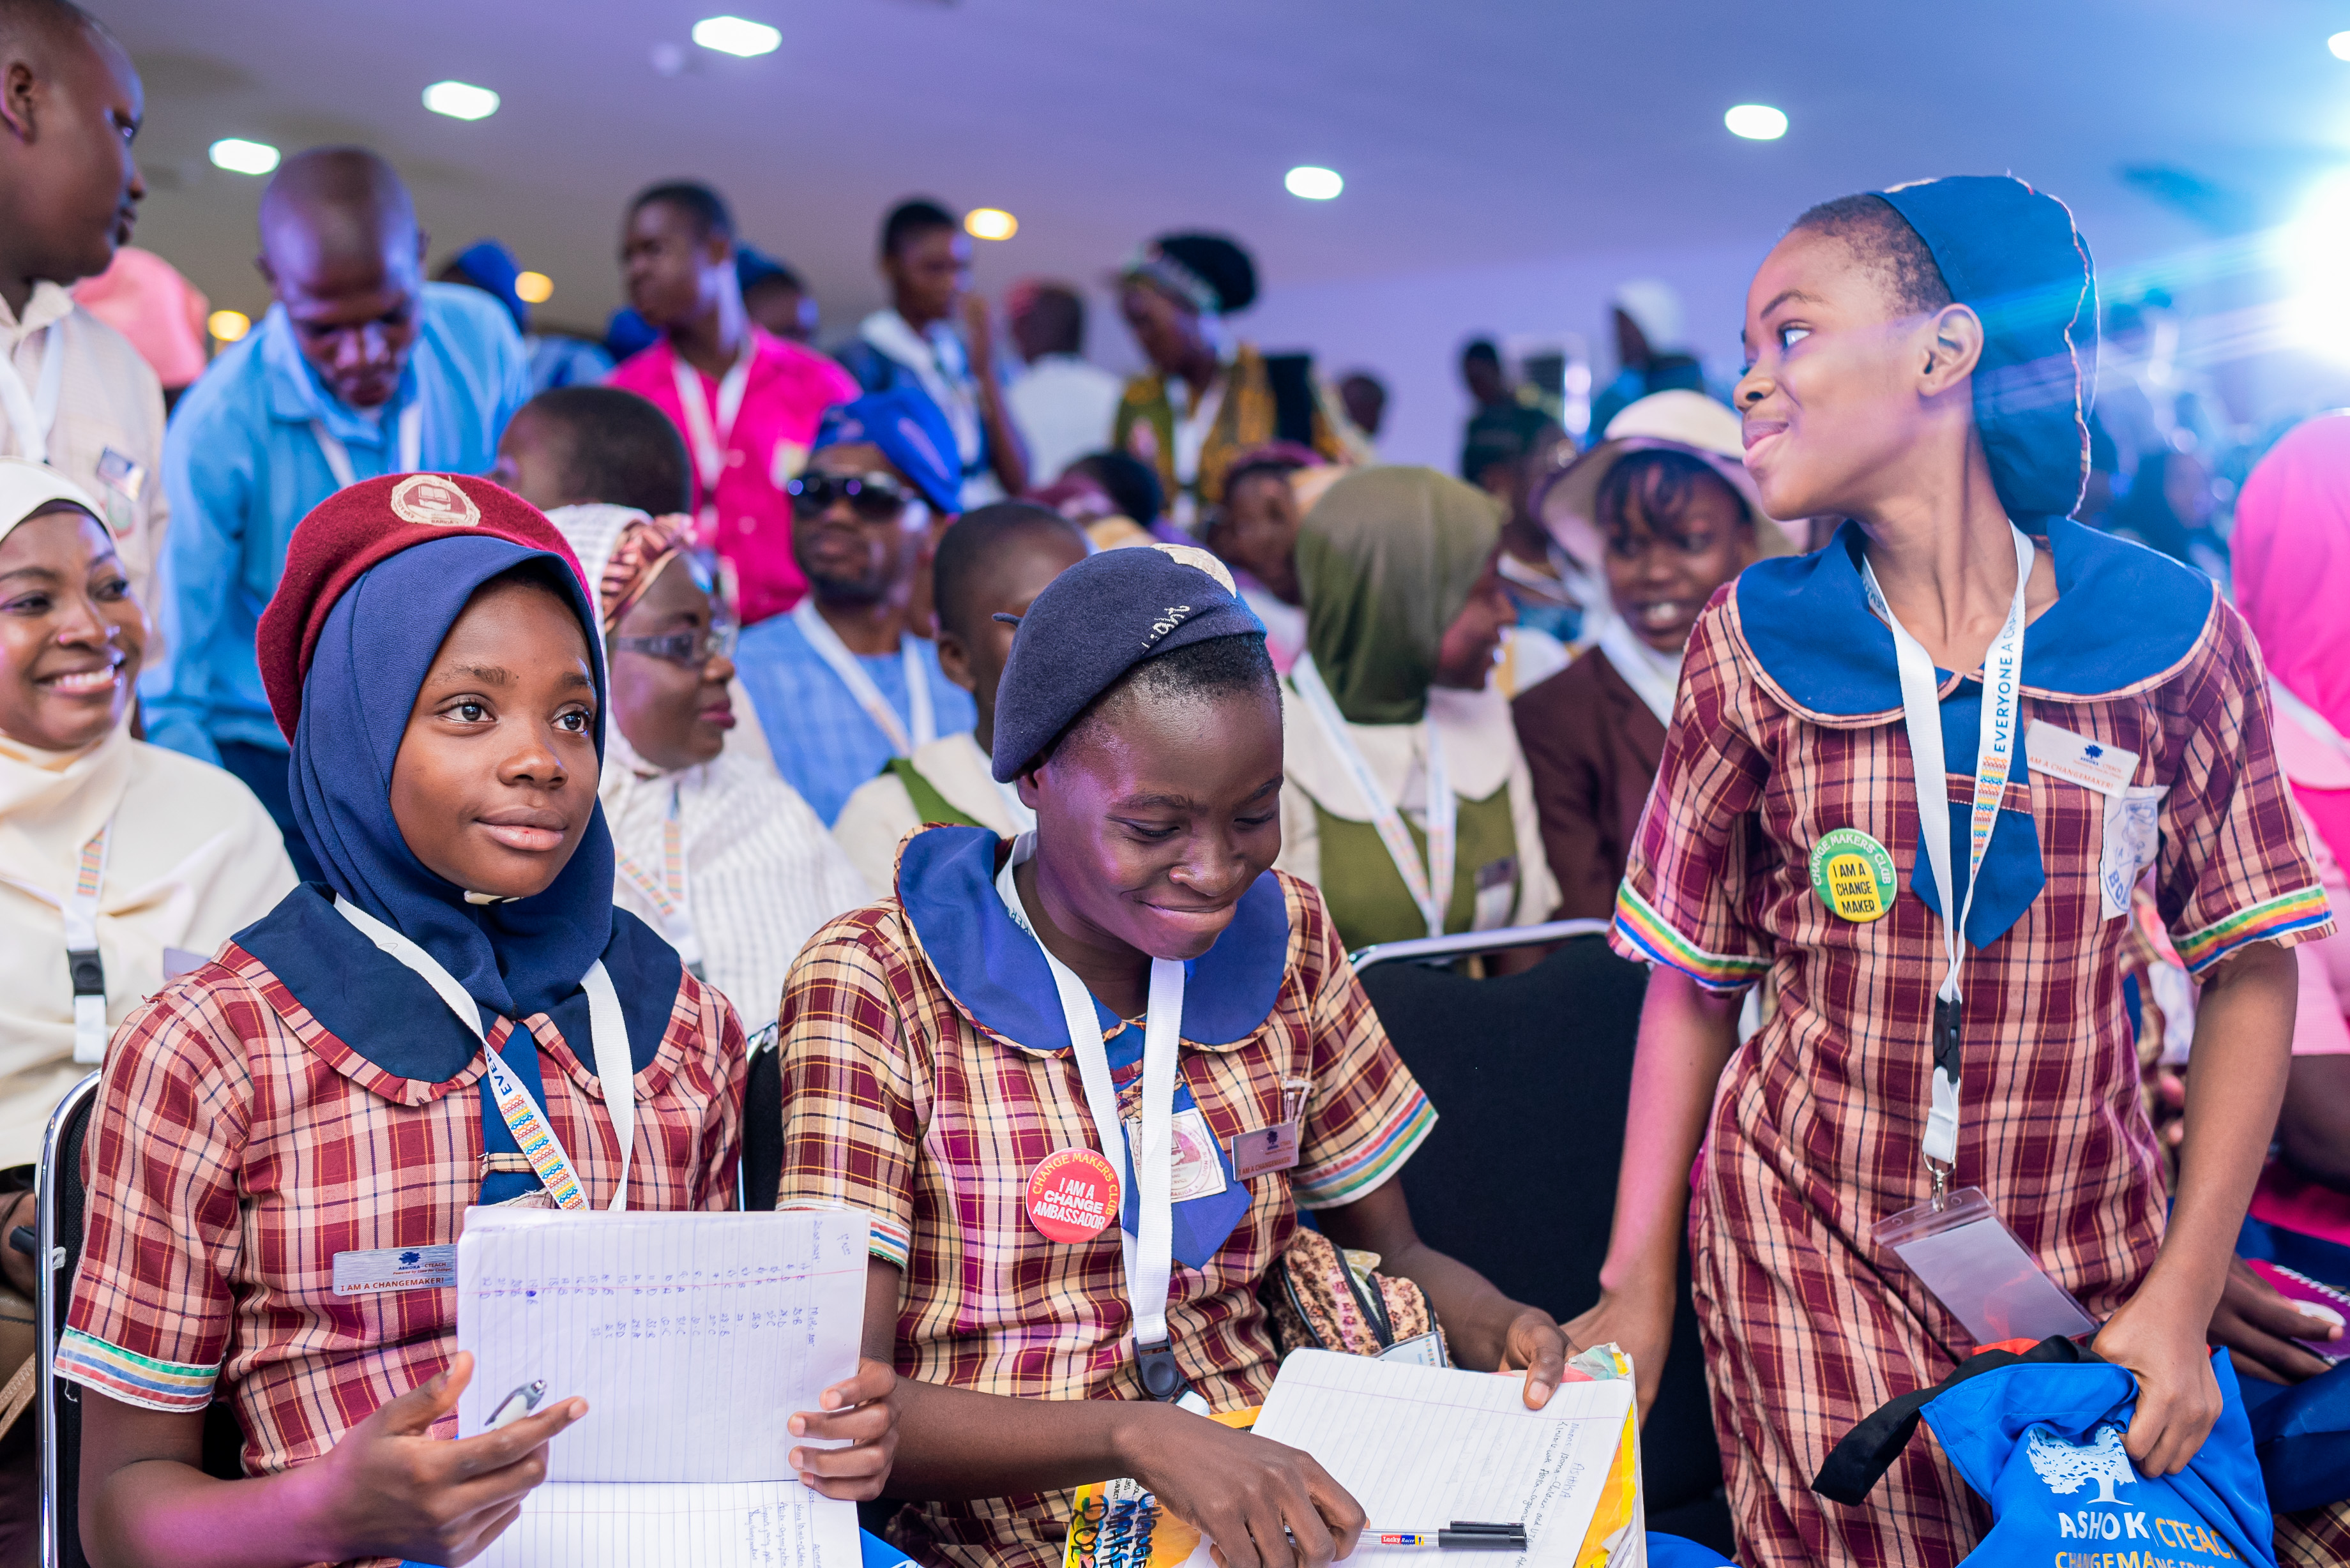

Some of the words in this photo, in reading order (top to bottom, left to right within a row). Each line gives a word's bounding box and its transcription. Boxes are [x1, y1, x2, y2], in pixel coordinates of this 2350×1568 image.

[2001, 642, 2013, 652] A
[1994, 656, 2012, 753] EVERYONE
[2029, 756, 2041, 764] AM
[2051, 764, 2114, 789] CHANGEMAKER!
[1812, 840, 1831, 886] CHANGE
[1830, 834, 1876, 854] MAKERS
[1874, 853, 1891, 884] CLUB
[1833, 865, 1837, 878] I
[1840, 864, 1856, 877] AM
[1859, 863, 1866, 876] A
[1836, 882, 1872, 896] CHANGE
[1842, 900, 1876, 914] MAKER
[1033, 1154, 1070, 1194] CHANGE
[1072, 1152, 1114, 1182] MAKERS
[1105, 1184, 1118, 1216] CLUB
[1059, 1177, 1065, 1192] I
[1065, 1179, 1086, 1197] AM
[1086, 1184, 1095, 1200] A
[1044, 1190, 1103, 1214] CHANGE
[1033, 1201, 1105, 1230] AMBASSADOR
[373, 1278, 444, 1288] CHANGEMAKER!
[1100, 1500, 1137, 1568] MAKE
[2058, 1511, 2151, 1541] ASHOK
